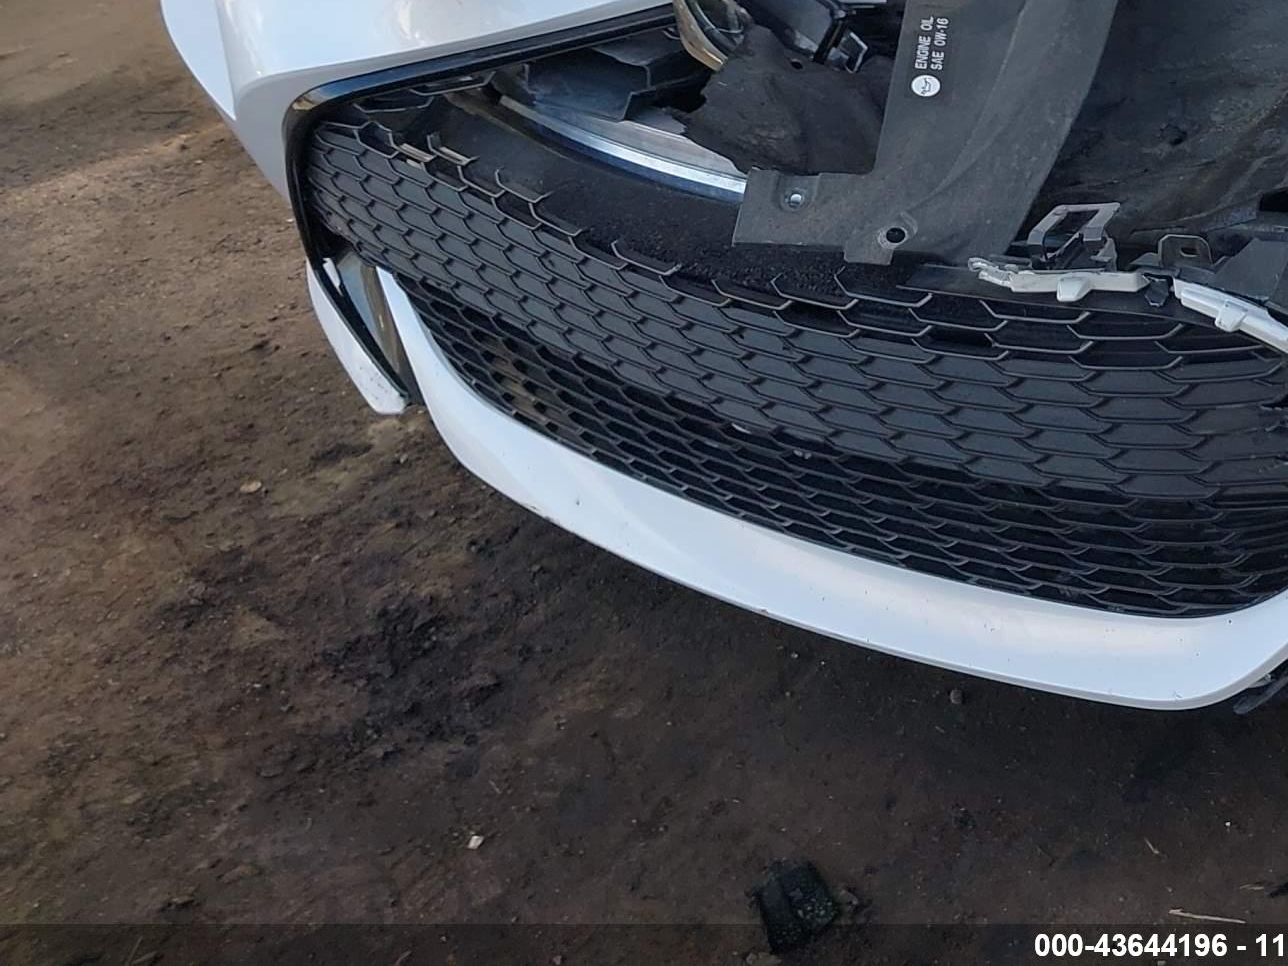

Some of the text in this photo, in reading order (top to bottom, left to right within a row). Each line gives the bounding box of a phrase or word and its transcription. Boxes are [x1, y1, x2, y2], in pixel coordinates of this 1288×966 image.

[914, 15, 934, 70] ENGINE OIL
[930, 17, 949, 71] SAE 0W-16
